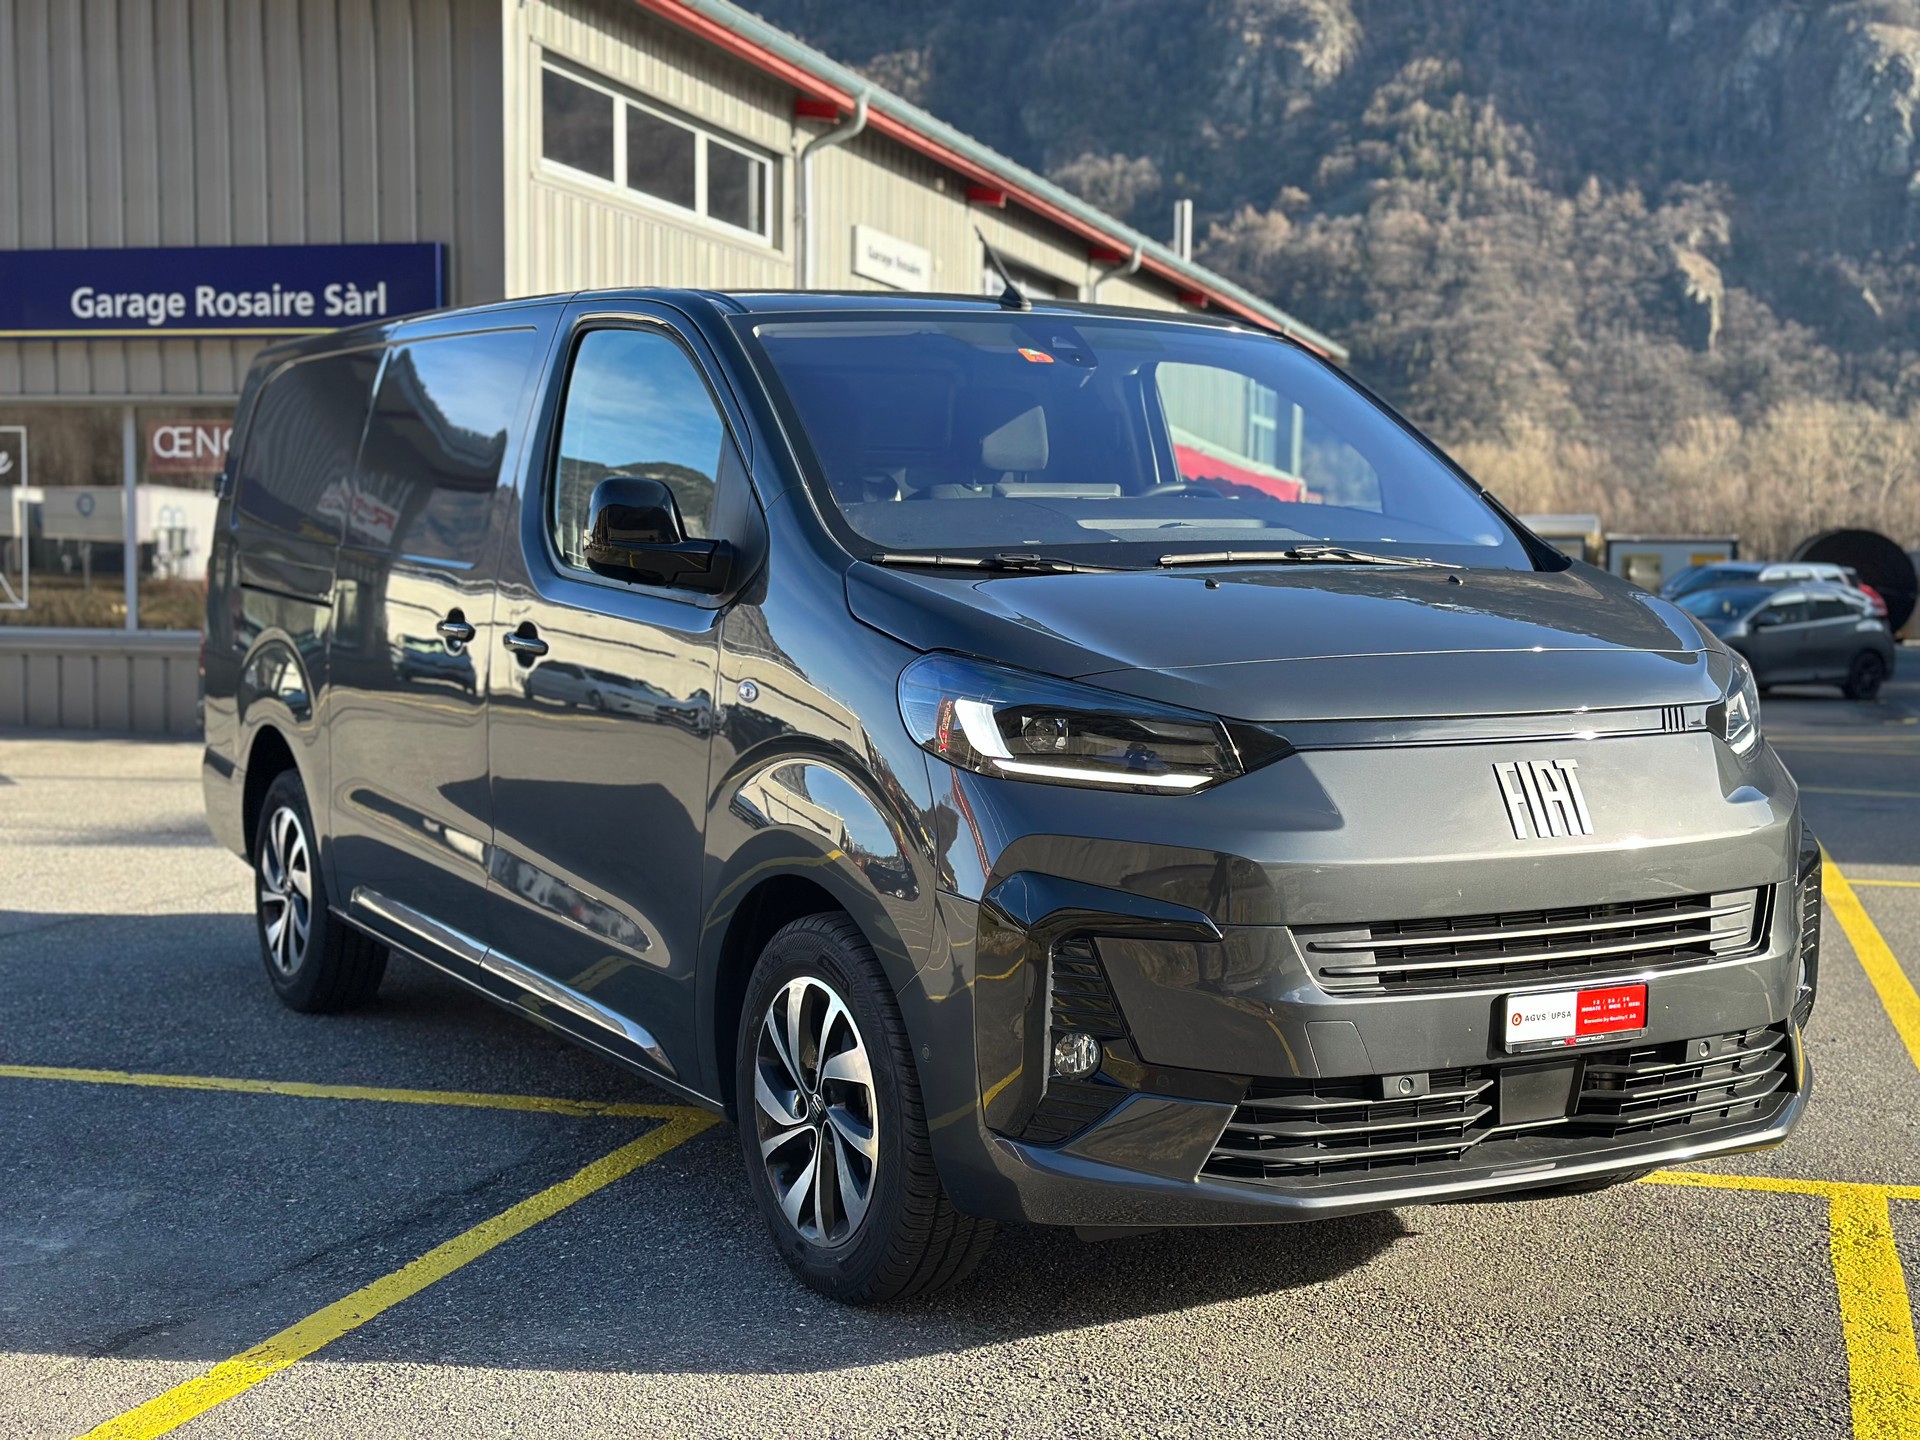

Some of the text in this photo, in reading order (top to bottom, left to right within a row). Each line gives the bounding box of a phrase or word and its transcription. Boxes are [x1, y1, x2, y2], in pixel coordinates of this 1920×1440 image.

[71, 281, 387, 326] Garage Rosaire Sàrl
[1492, 758, 1594, 840] FIAT
[1524, 1010, 1572, 1022] AGVS UPSA
